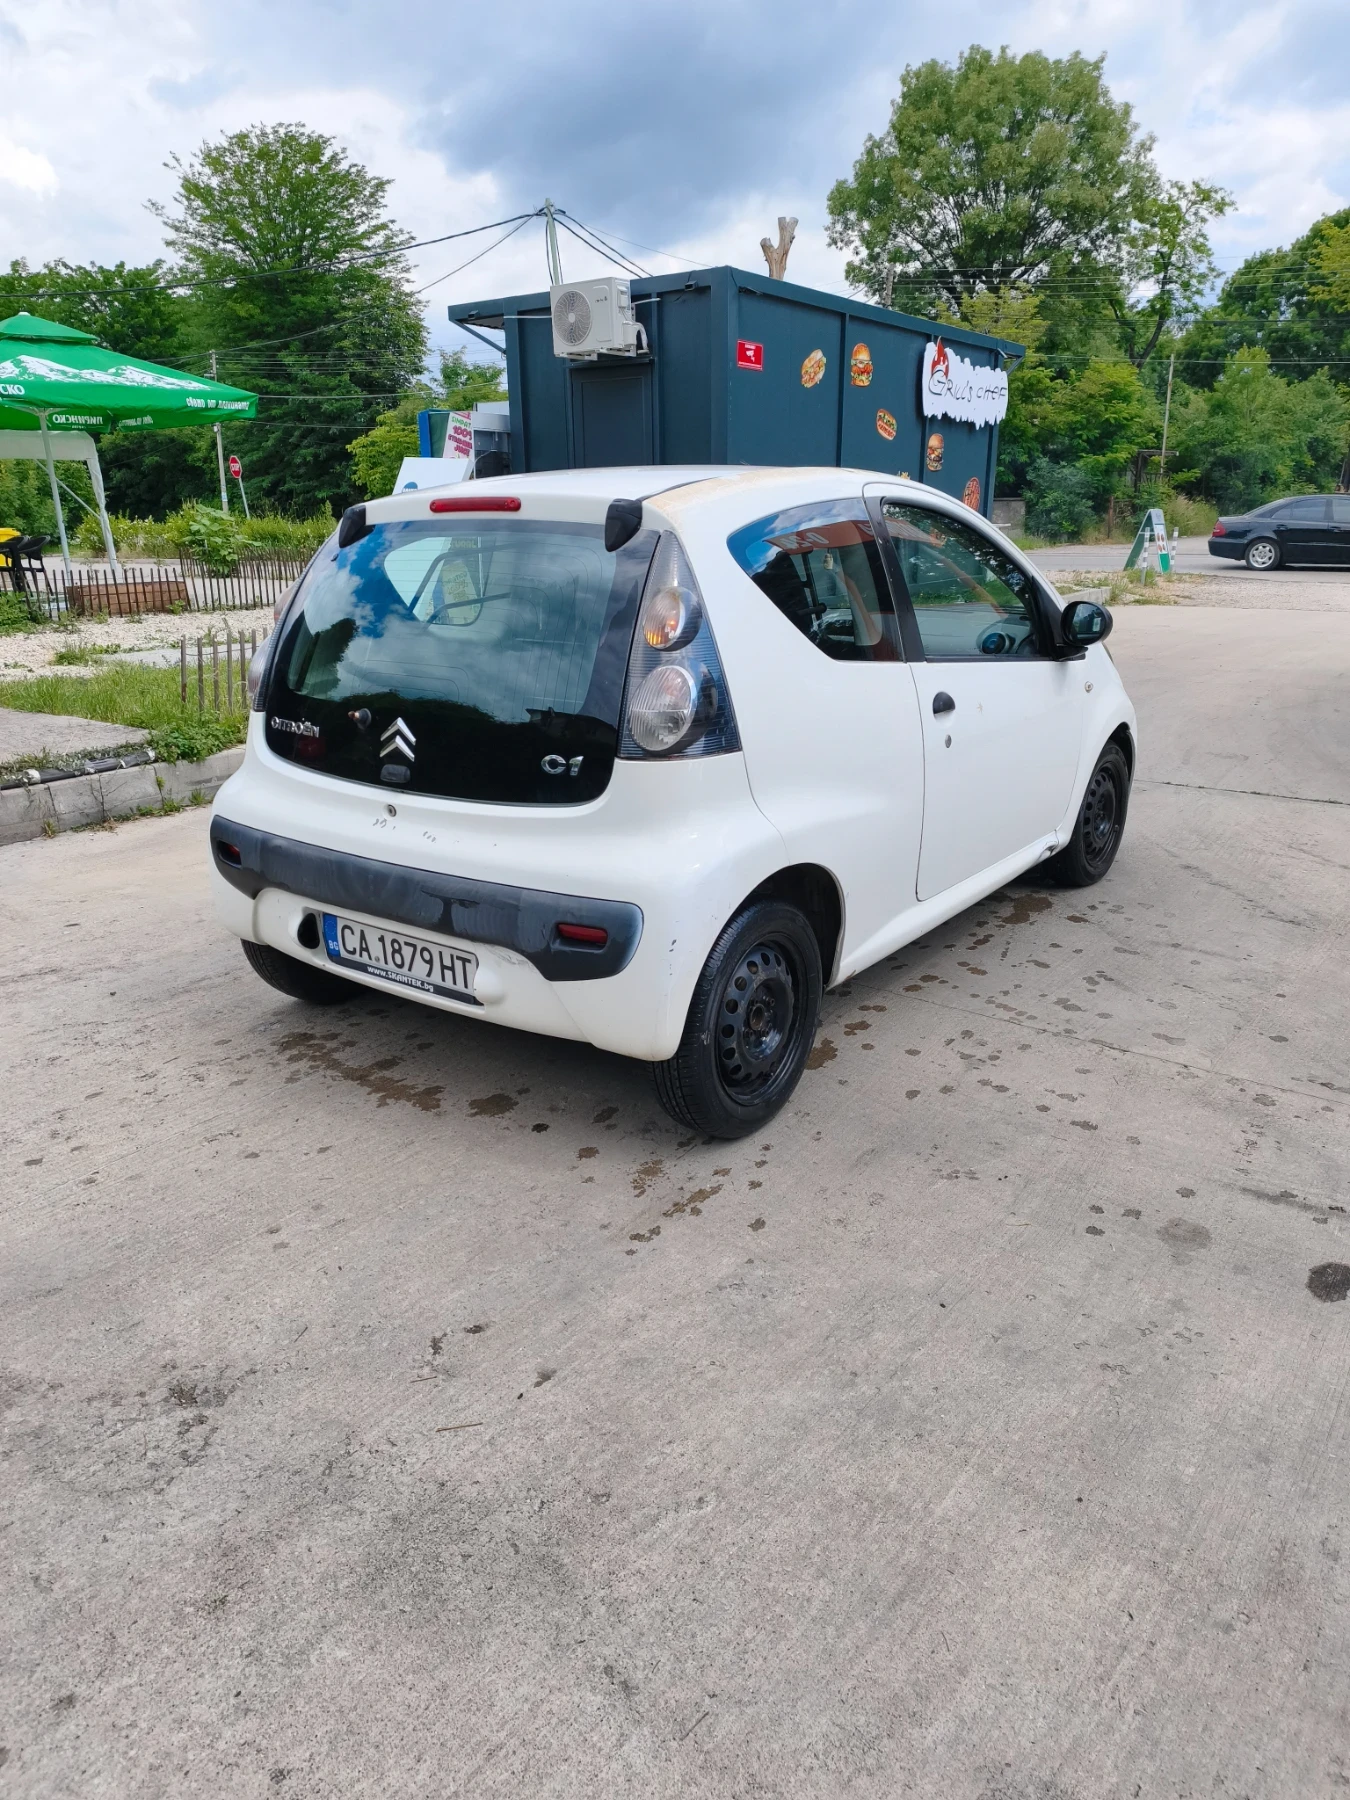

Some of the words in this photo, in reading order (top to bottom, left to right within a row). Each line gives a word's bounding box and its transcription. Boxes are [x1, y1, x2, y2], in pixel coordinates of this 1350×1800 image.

[0, 383, 25, 395] СКО
[540, 754, 584, 776] C1
[328, 939, 339, 951] BG
